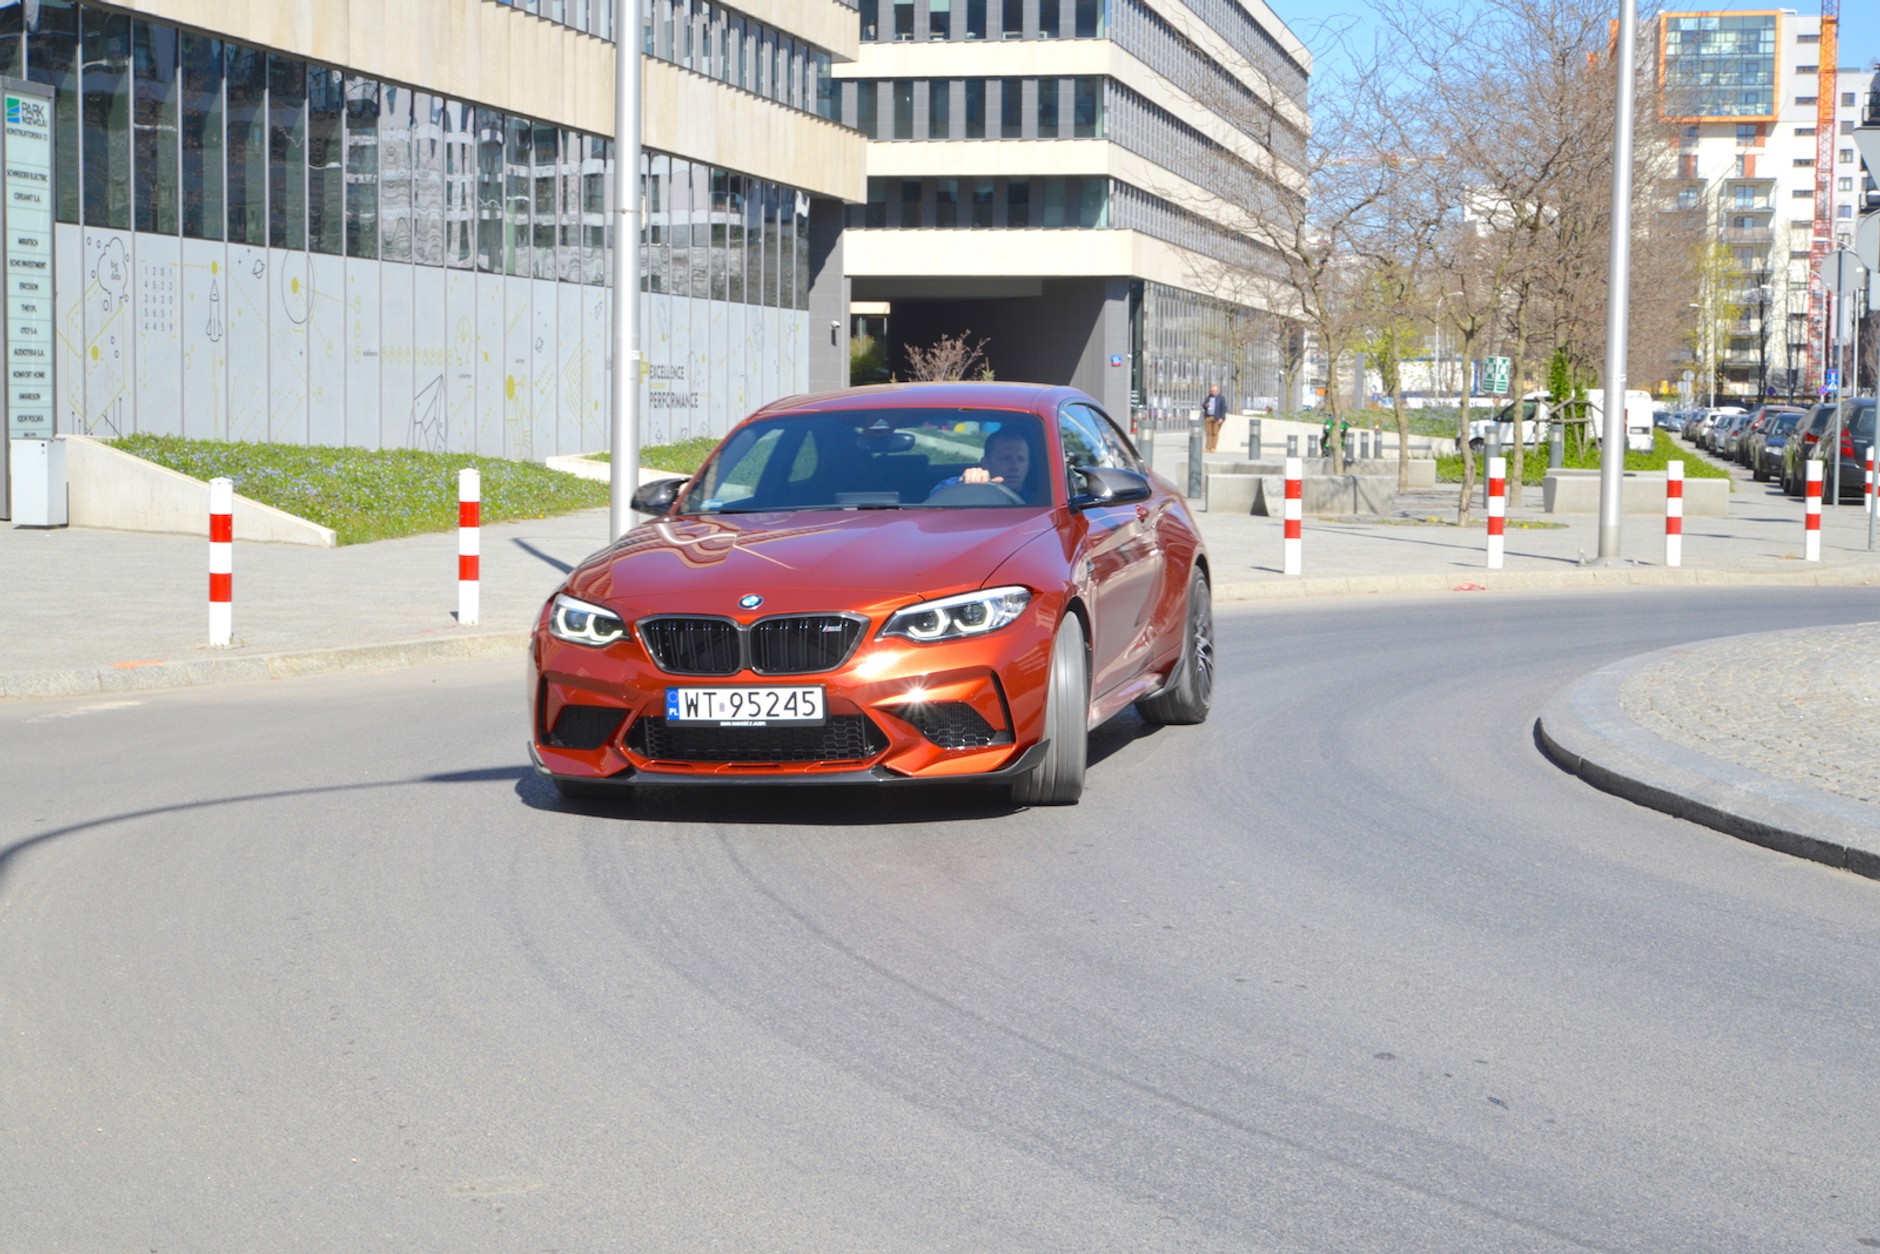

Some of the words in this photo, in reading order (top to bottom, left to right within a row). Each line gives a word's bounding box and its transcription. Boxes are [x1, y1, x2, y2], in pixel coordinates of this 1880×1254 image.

[22, 101, 45, 119] PARK
[7, 169, 30, 179] SCHNEIDER
[30, 172, 48, 183] ELECTRIC
[650, 365, 684, 379] EXCELLENCE
[650, 392, 698, 408] PERFORMANCE
[669, 708, 679, 716] PL
[685, 692, 717, 718] WT
[730, 691, 816, 718] 95245
